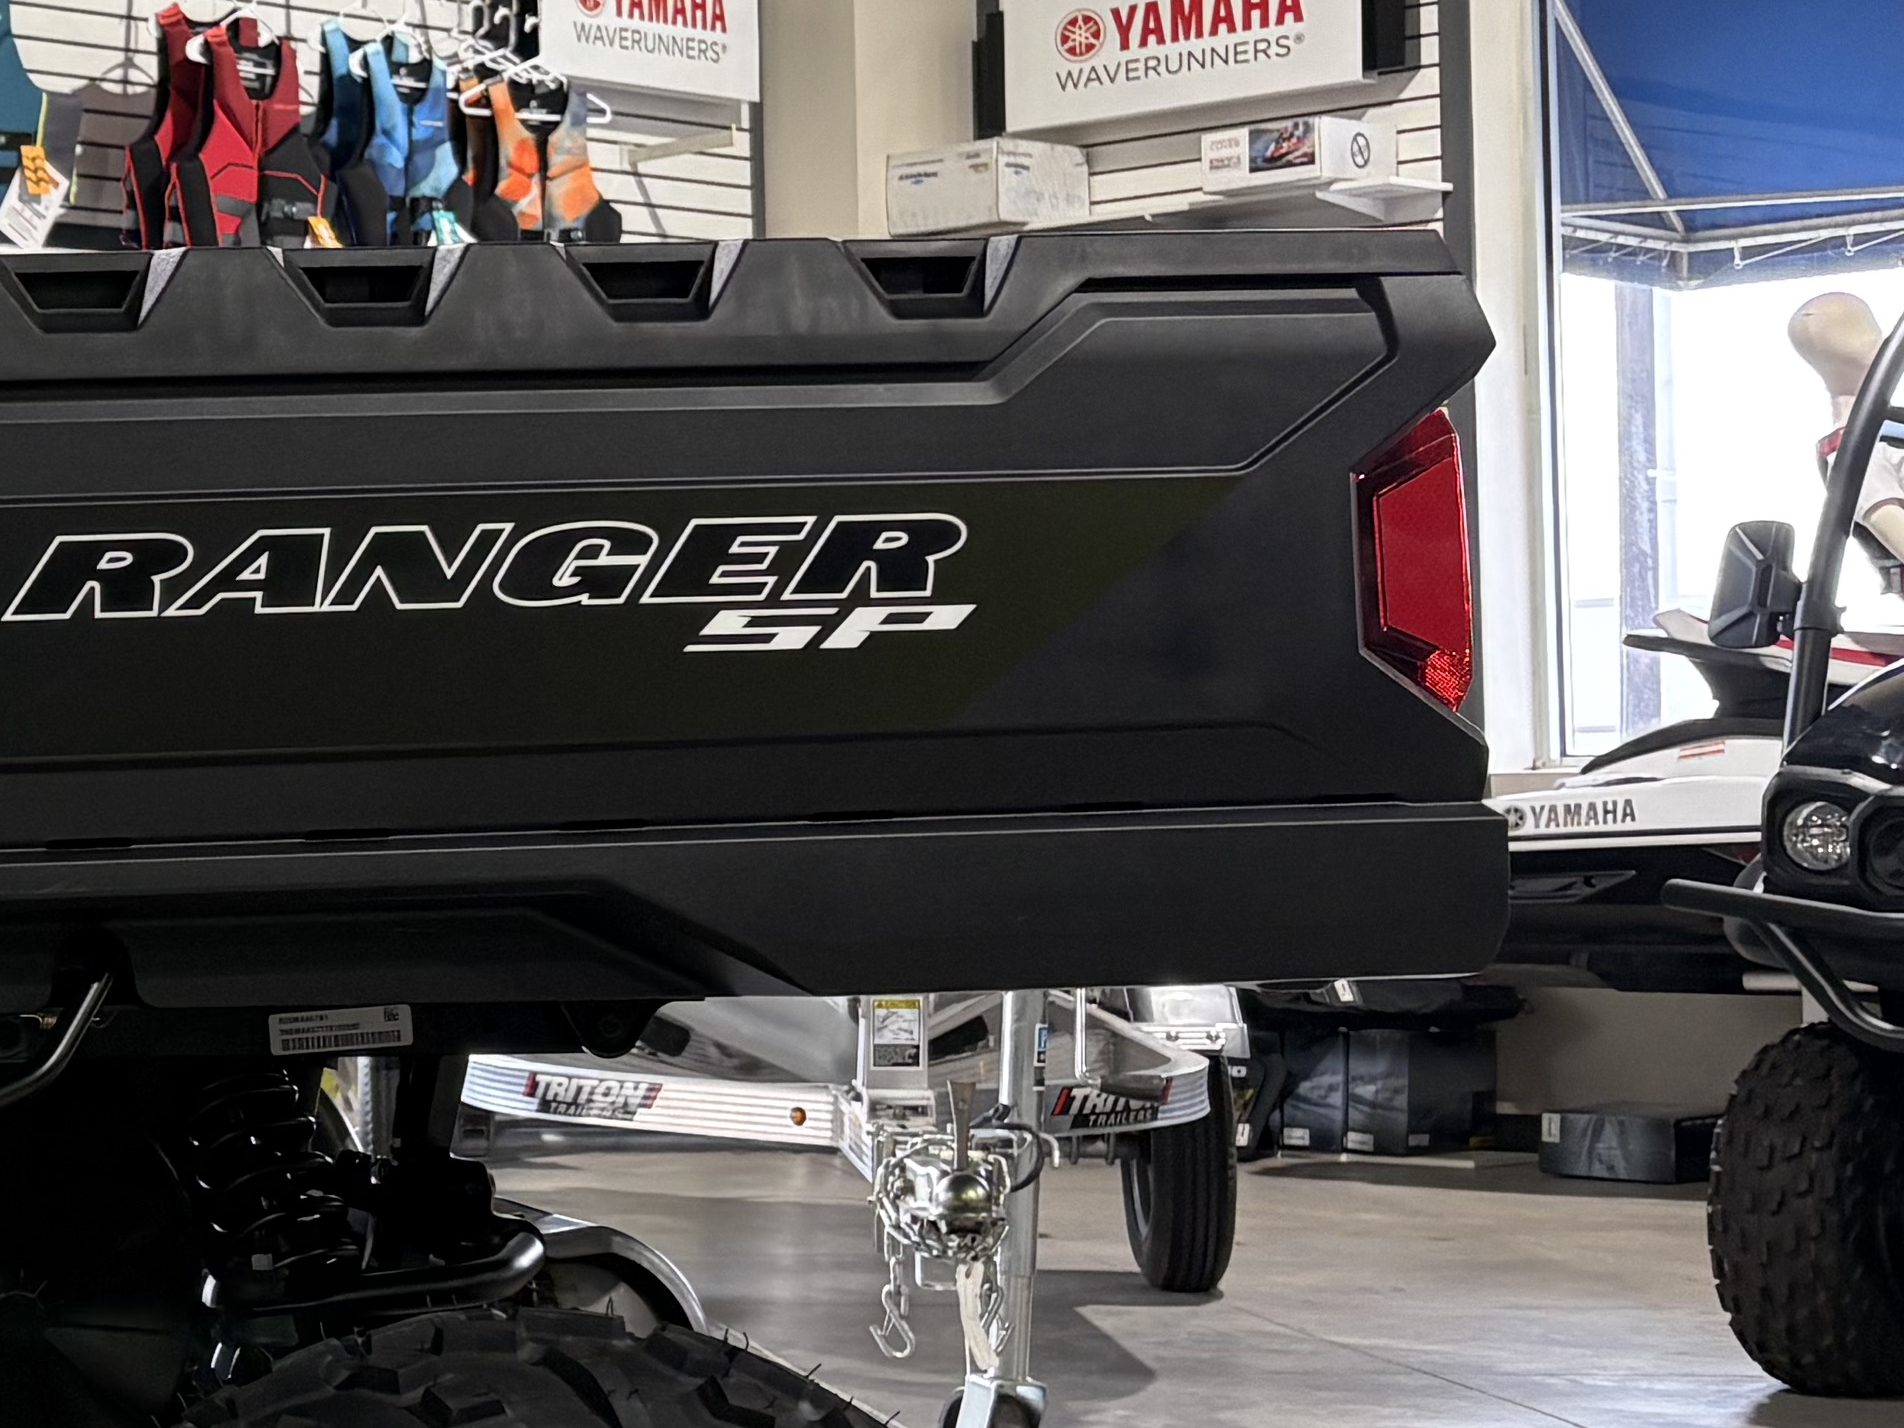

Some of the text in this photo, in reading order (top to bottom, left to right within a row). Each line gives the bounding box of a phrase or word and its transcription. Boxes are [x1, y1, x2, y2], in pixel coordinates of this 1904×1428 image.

[2, 514, 968, 621] RANGER
[683, 604, 976, 653] SP
[1530, 799, 1636, 829] YAMAHA
[534, 1074, 649, 1110] TRITON
[1089, 1109, 1153, 1127] TRAILERS
